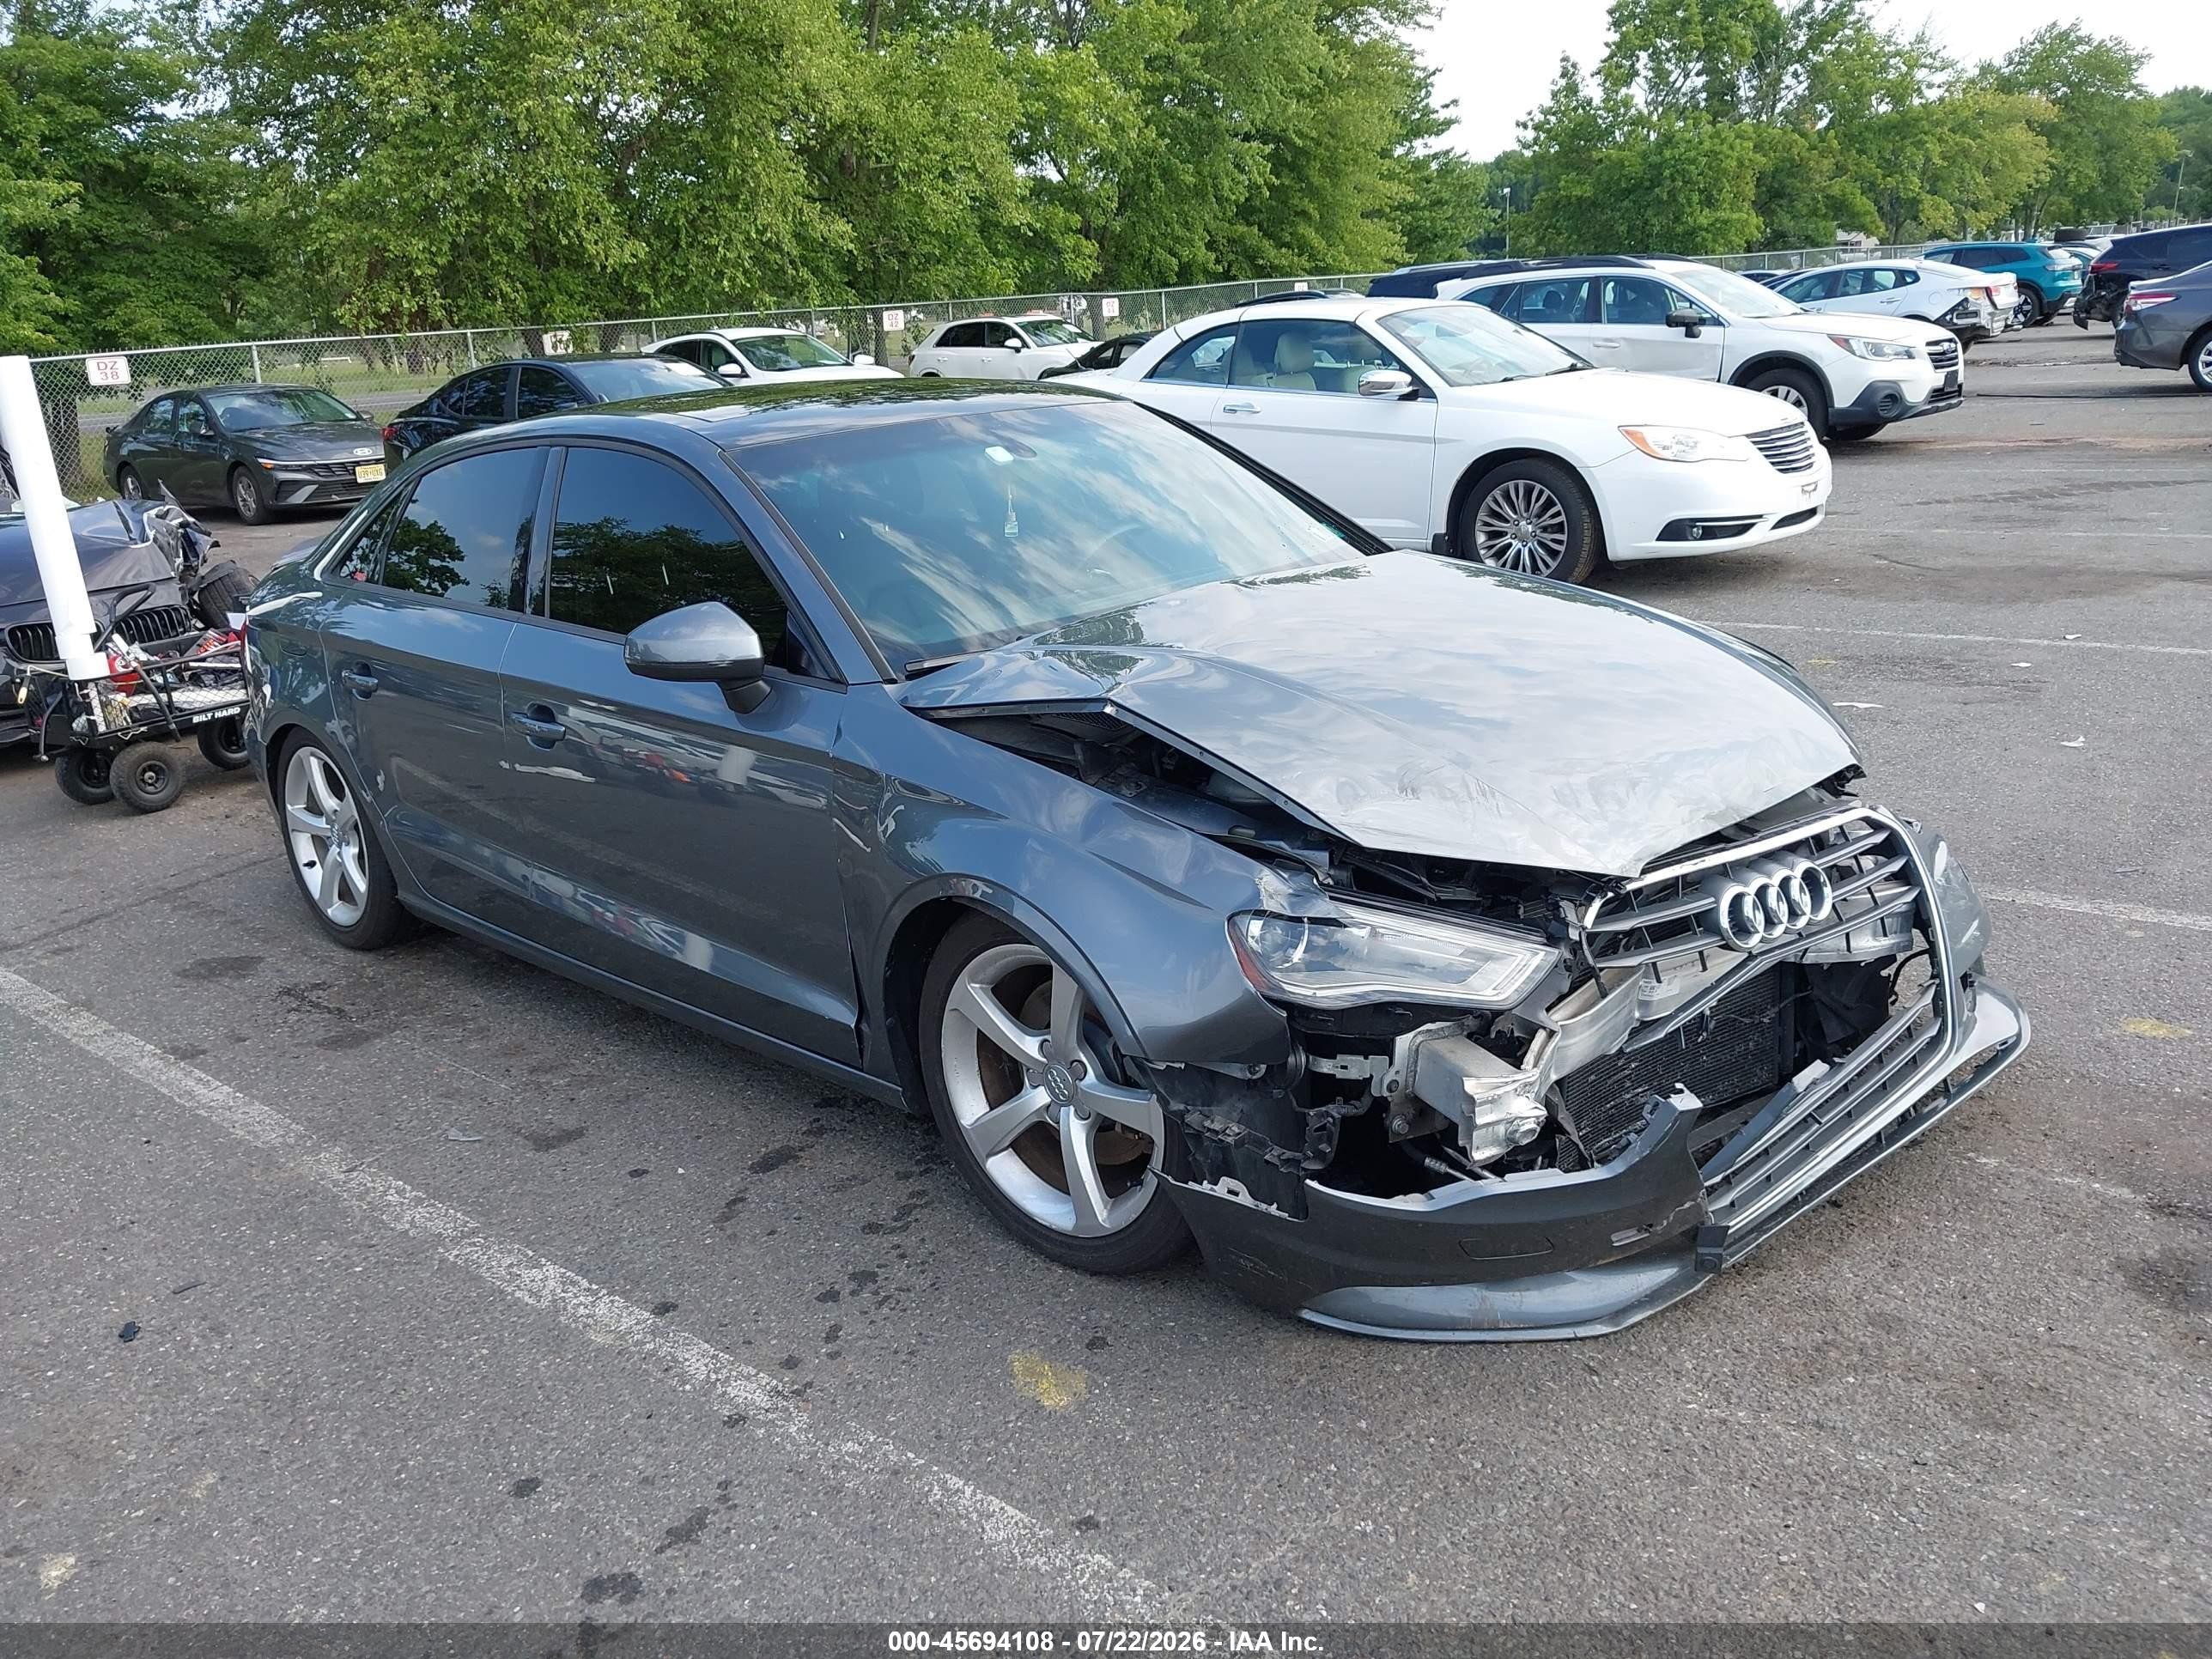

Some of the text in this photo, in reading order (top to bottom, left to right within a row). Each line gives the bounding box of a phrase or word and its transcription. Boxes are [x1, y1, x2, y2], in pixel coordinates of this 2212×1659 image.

[96, 361, 118, 371] DZ
[100, 371, 119, 380] 38
[192, 707, 240, 723] BILT HARD
